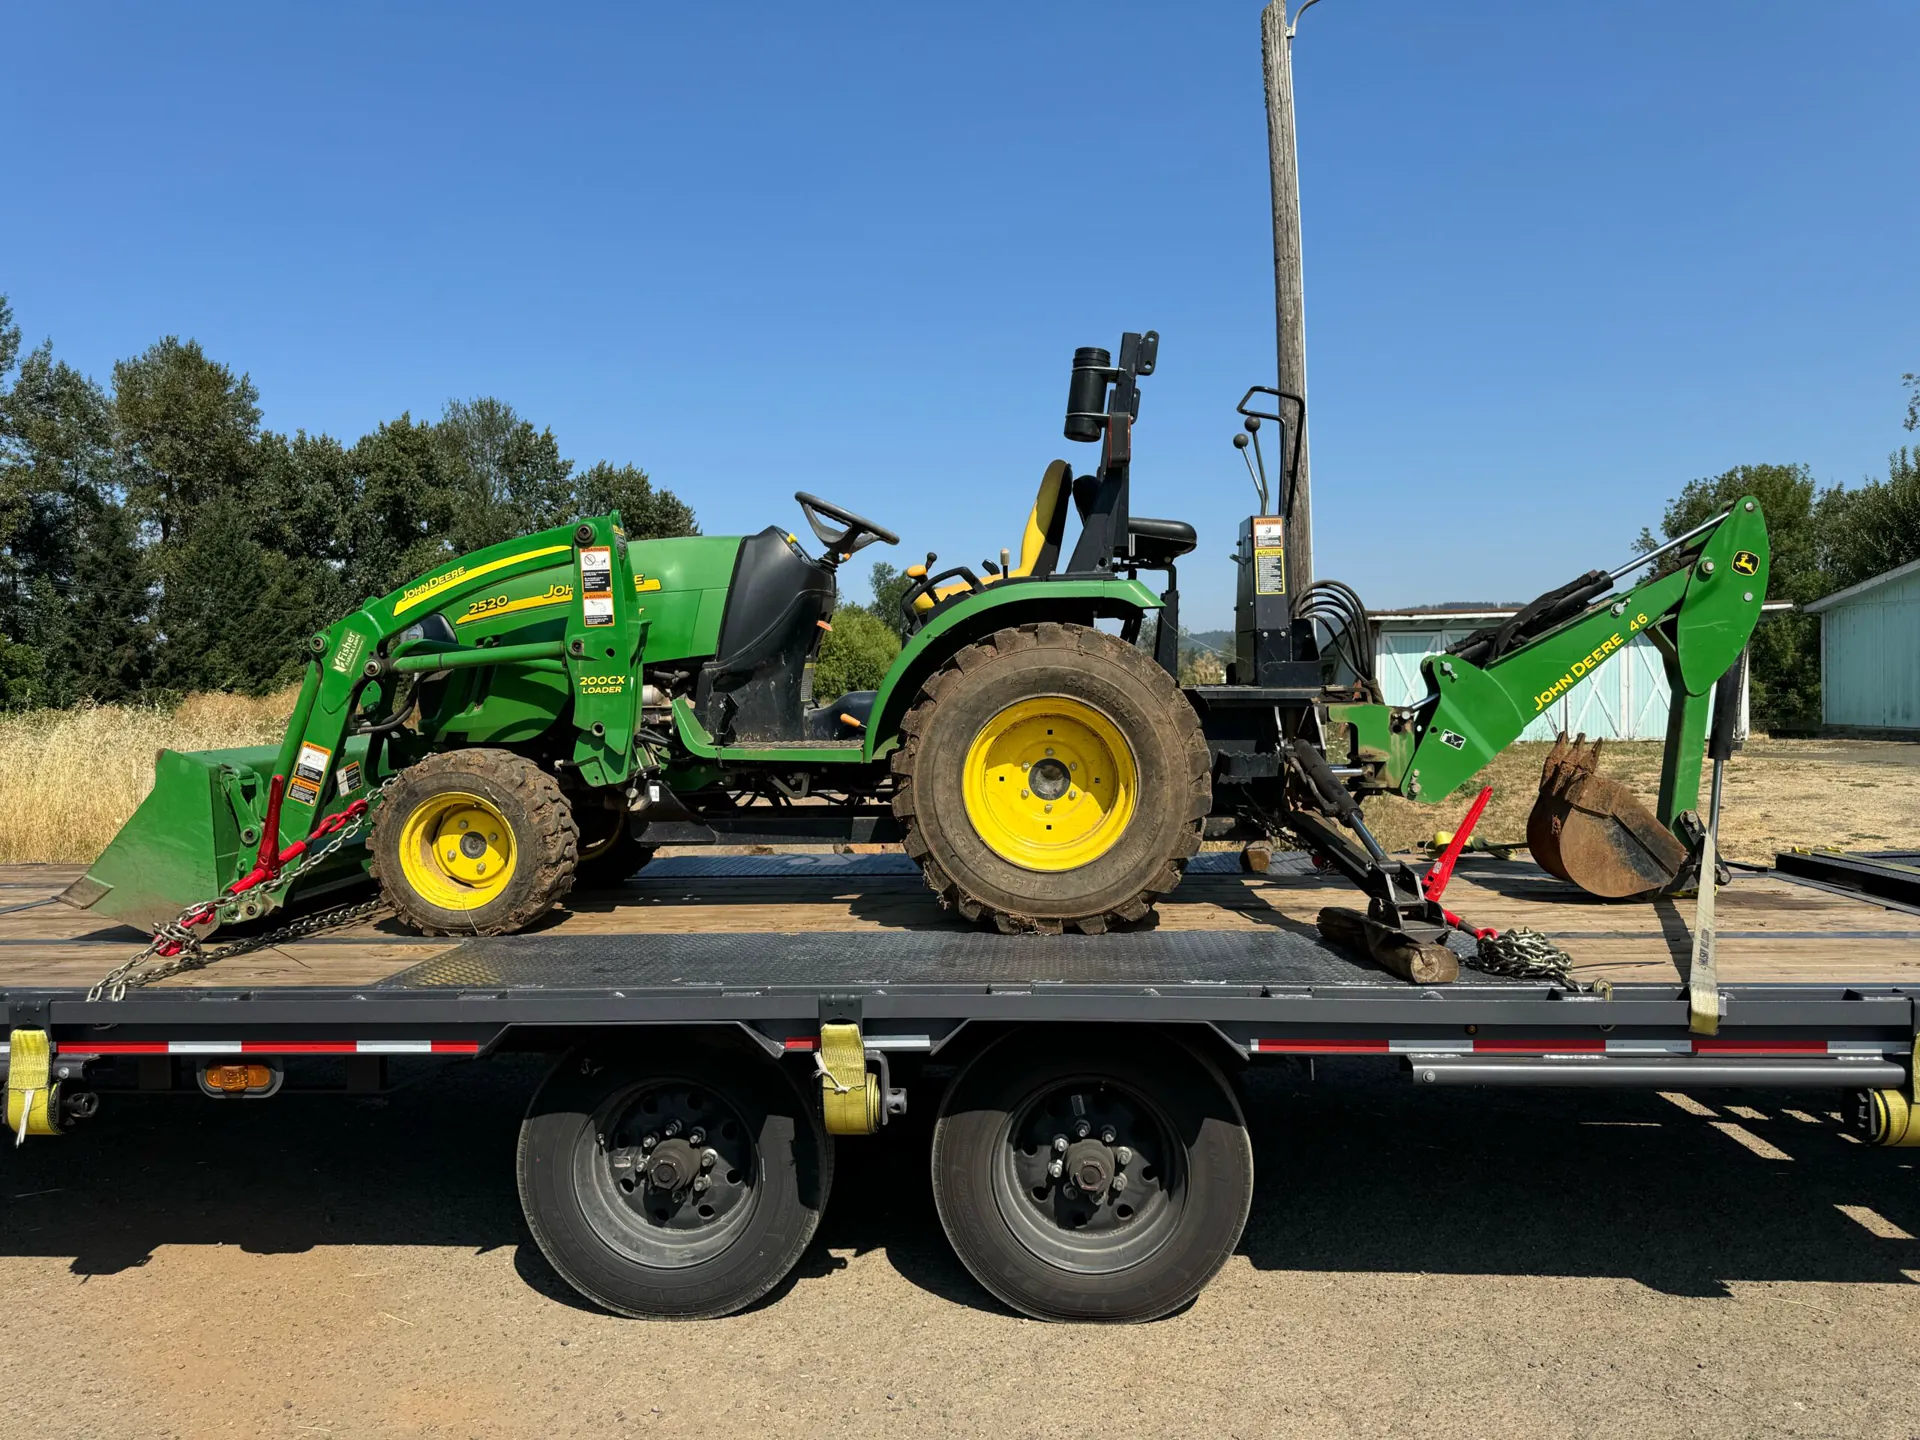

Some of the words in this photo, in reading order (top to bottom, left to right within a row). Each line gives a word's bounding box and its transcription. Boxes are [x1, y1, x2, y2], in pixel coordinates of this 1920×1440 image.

[401, 582, 429, 602] JOHN
[429, 566, 467, 588] DEERE
[543, 584, 573, 598] JOH
[468, 594, 508, 615] 2520
[337, 631, 356, 661] Fisher
[1534, 673, 1574, 711] JOHN
[1570, 632, 1624, 678] DEERE
[1629, 613, 1648, 632] 46
[579, 675, 626, 686] 200CX
[582, 686, 622, 694] LOADER
